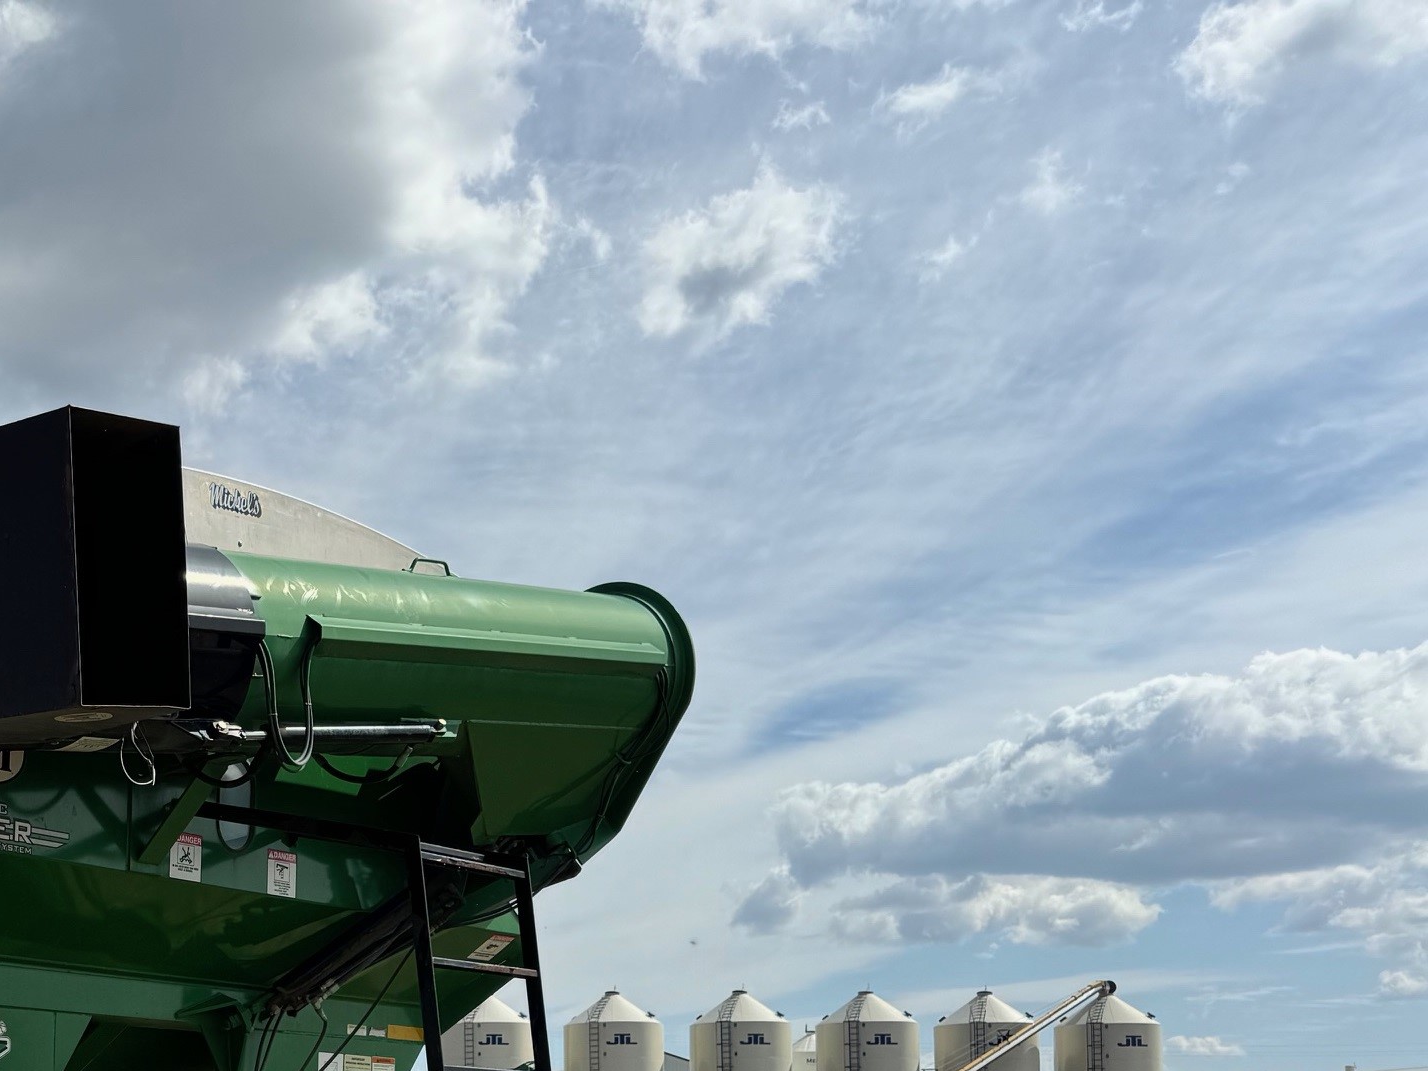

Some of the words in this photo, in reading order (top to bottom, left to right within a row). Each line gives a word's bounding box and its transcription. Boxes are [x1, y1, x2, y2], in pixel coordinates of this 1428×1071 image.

[478, 1034, 509, 1045] JTL
[606, 1033, 638, 1045] JTL
[740, 1033, 771, 1045] JTL
[866, 1033, 898, 1045] JTL
[1117, 1035, 1148, 1047] JTL
